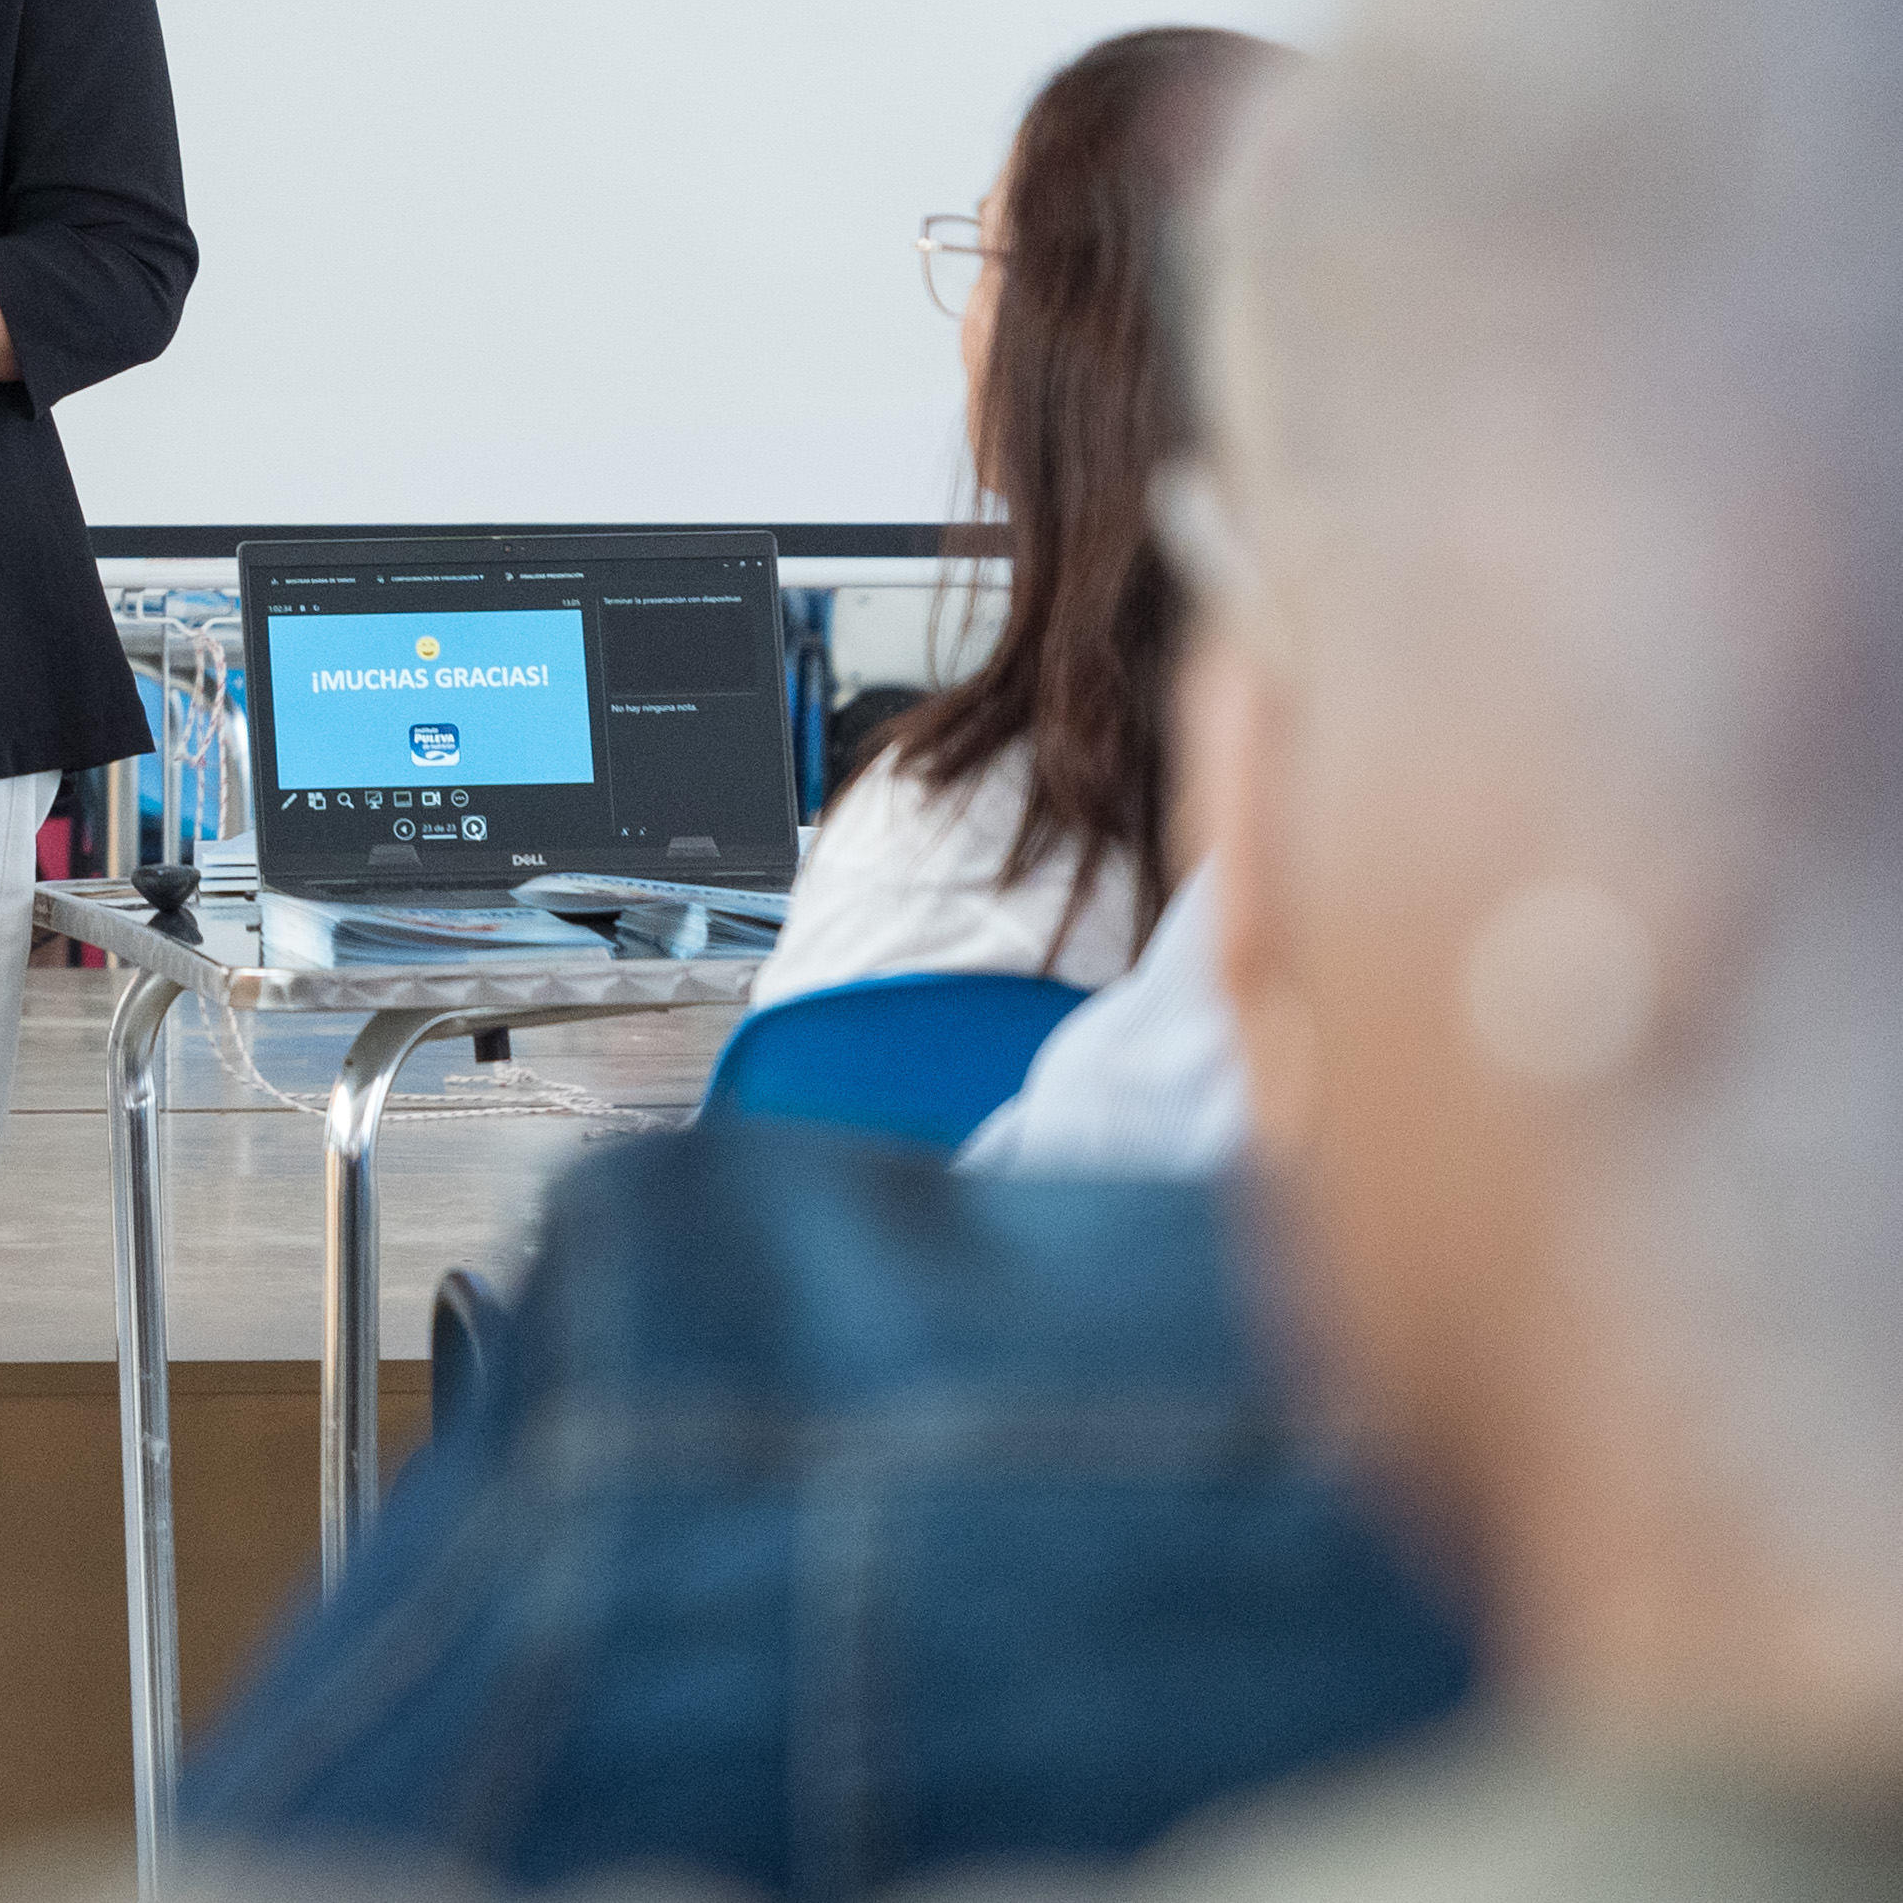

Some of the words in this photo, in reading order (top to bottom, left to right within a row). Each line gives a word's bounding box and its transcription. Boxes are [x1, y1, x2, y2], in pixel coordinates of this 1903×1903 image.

[311, 668, 429, 693] ¡MUCHAS
[435, 664, 549, 689] GRACIAS!
[611, 704, 625, 713] No
[625, 704, 641, 715] hay
[511, 853, 547, 867] DELL
